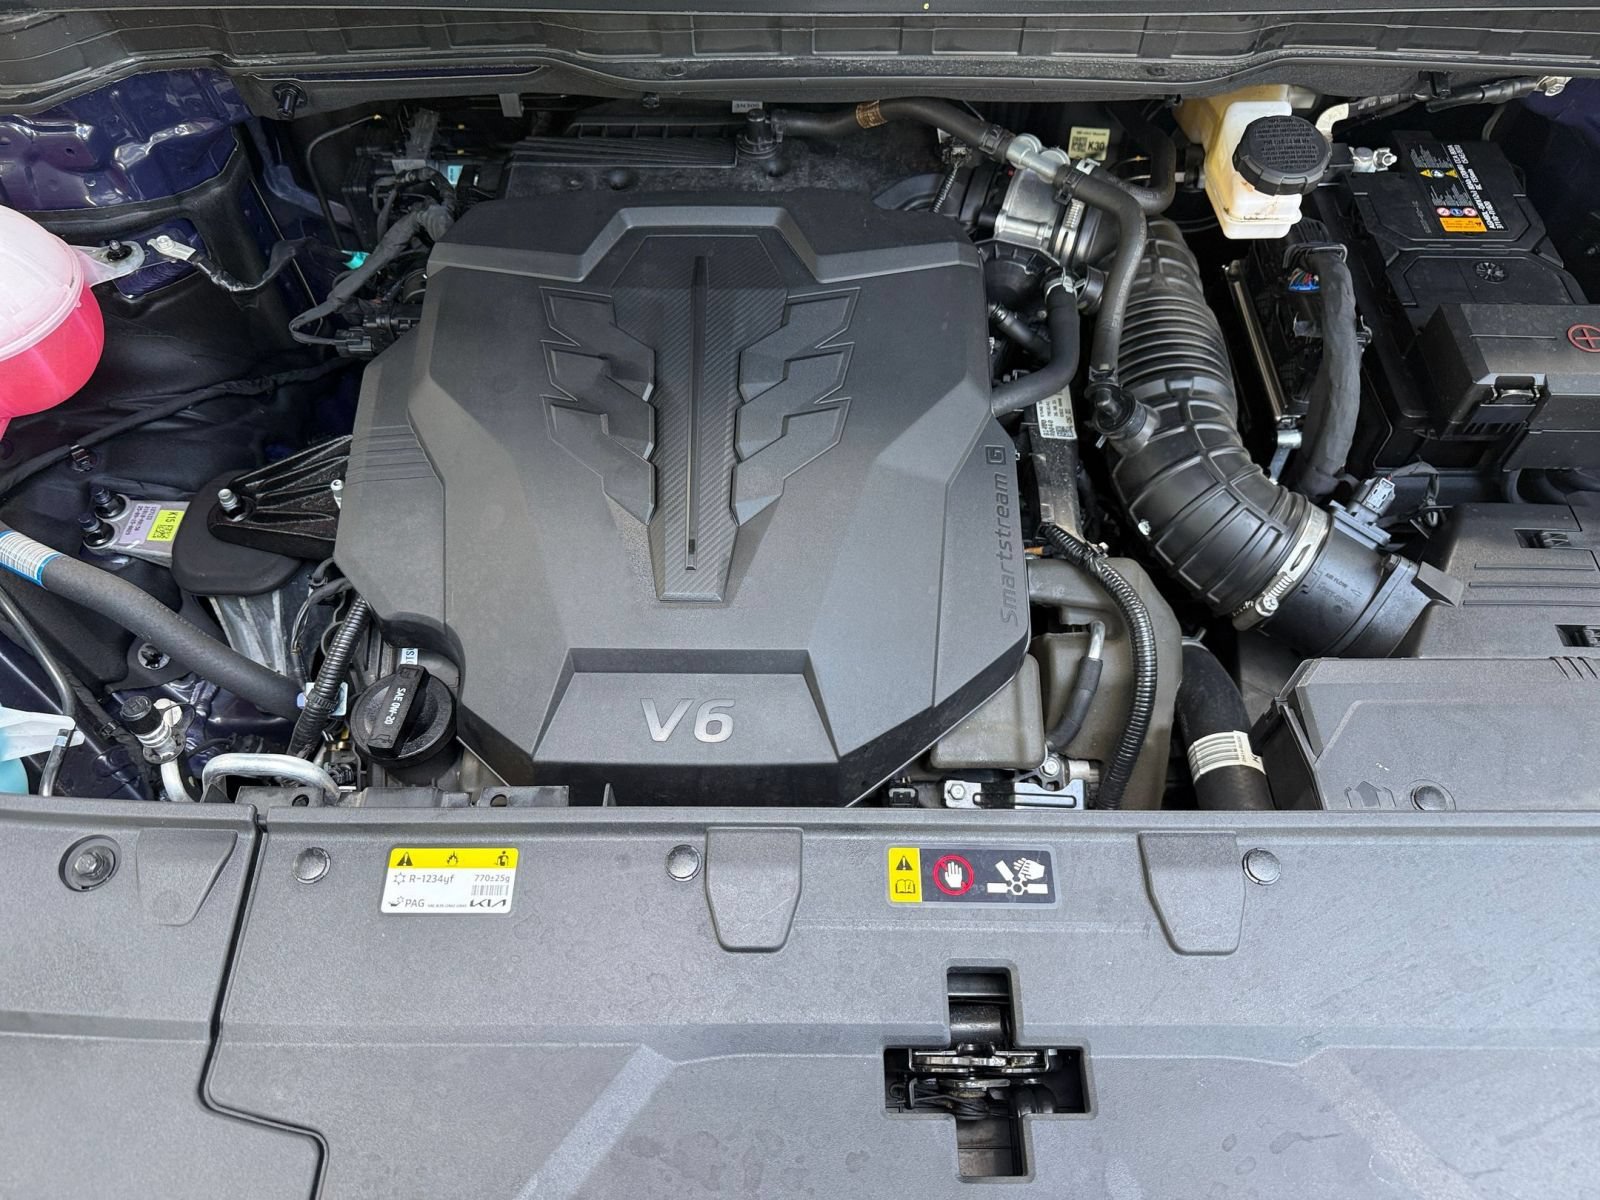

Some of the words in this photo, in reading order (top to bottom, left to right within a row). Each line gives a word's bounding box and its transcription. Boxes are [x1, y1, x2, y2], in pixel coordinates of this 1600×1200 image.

[165, 511, 178, 523] K15
[994, 472, 1018, 627] Smartstream
[1333, 577, 1348, 588] FLOW
[393, 687, 406, 702] SAE
[384, 702, 401, 725] 0W-20
[640, 698, 736, 743] V6
[409, 874, 455, 885] R-1234yf
[474, 874, 510, 883] 770±25g
[404, 898, 425, 908] PAG
[469, 898, 507, 908] KIA
